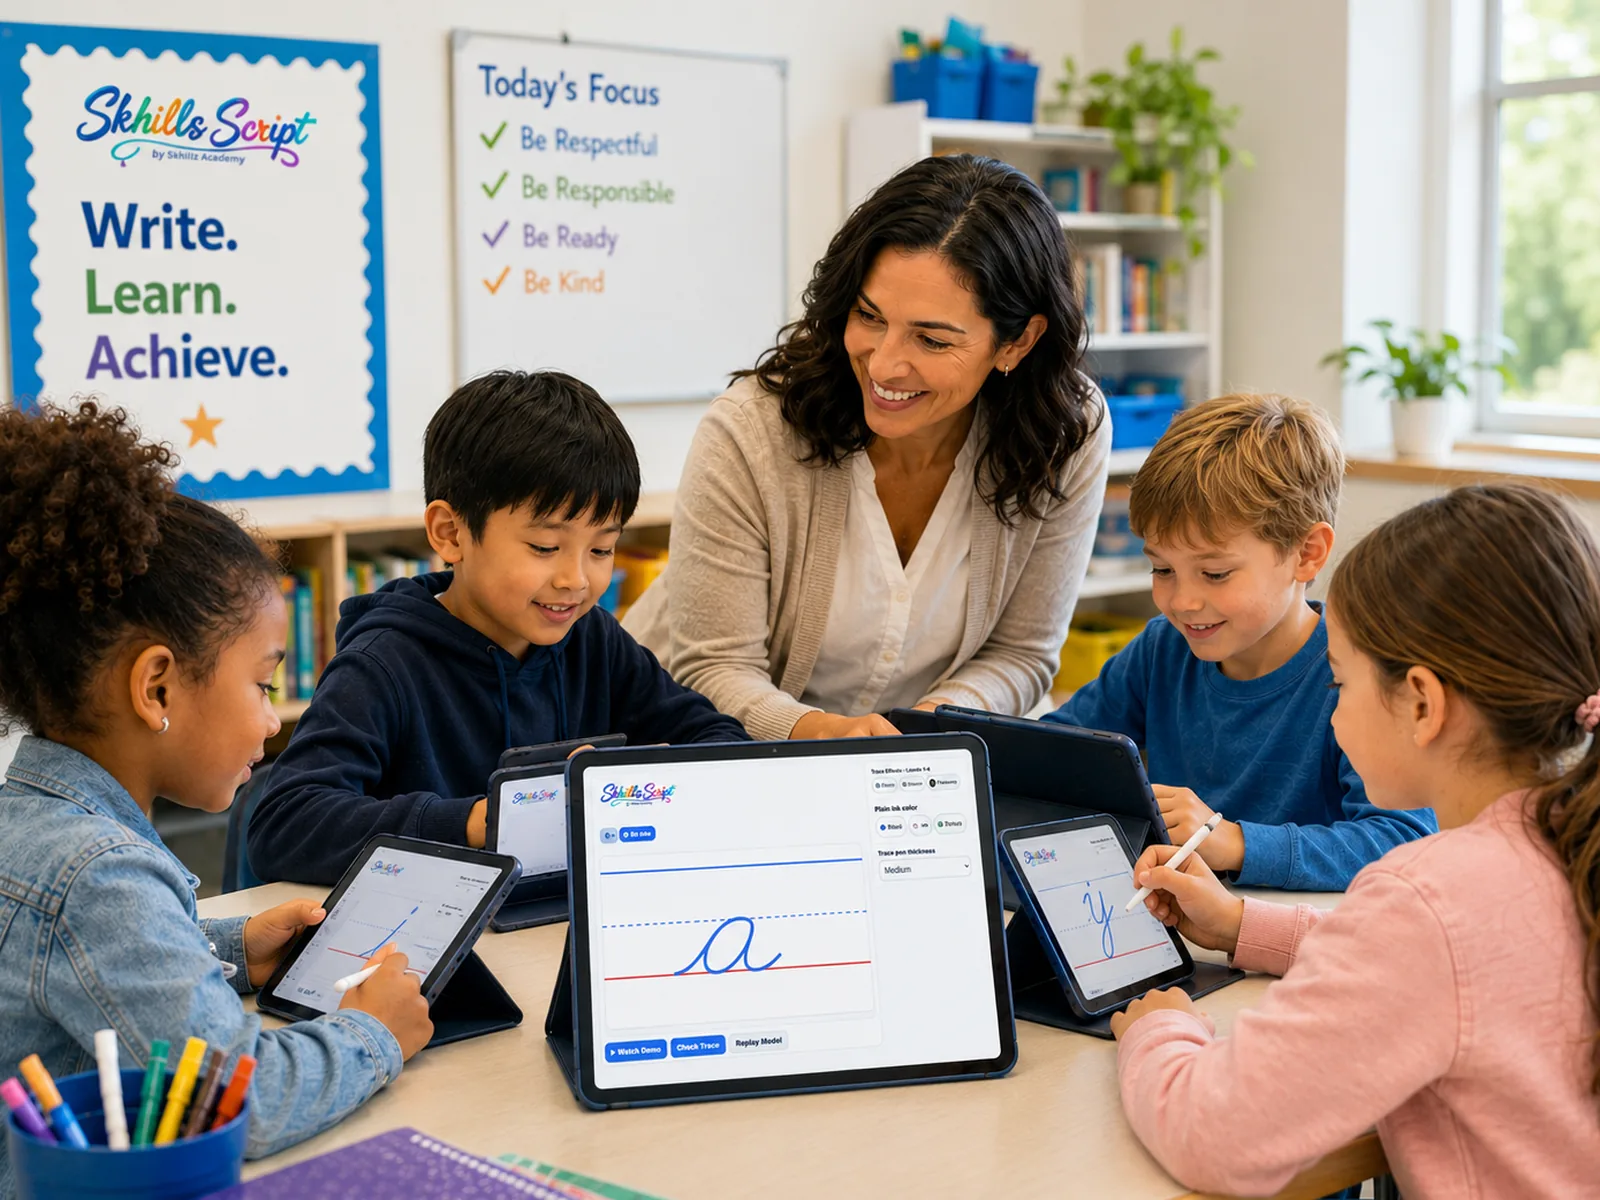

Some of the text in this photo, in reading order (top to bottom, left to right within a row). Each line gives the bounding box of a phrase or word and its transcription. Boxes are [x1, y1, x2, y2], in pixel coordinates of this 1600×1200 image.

[478, 64, 659, 108] Today's Focus
[76, 85, 317, 161] Skhills Script
[152, 149, 165, 160] by
[201, 153, 245, 165] Academy
[520, 125, 658, 160] Be Respectful
[522, 174, 675, 208] Be Responsible
[81, 201, 238, 250] Write.
[523, 223, 619, 256] Be Ready
[85, 268, 237, 315] Learn.
[524, 268, 605, 294] Be Kind
[85, 332, 289, 380] Achieve.
[735, 1036, 783, 1048] Replay Model
